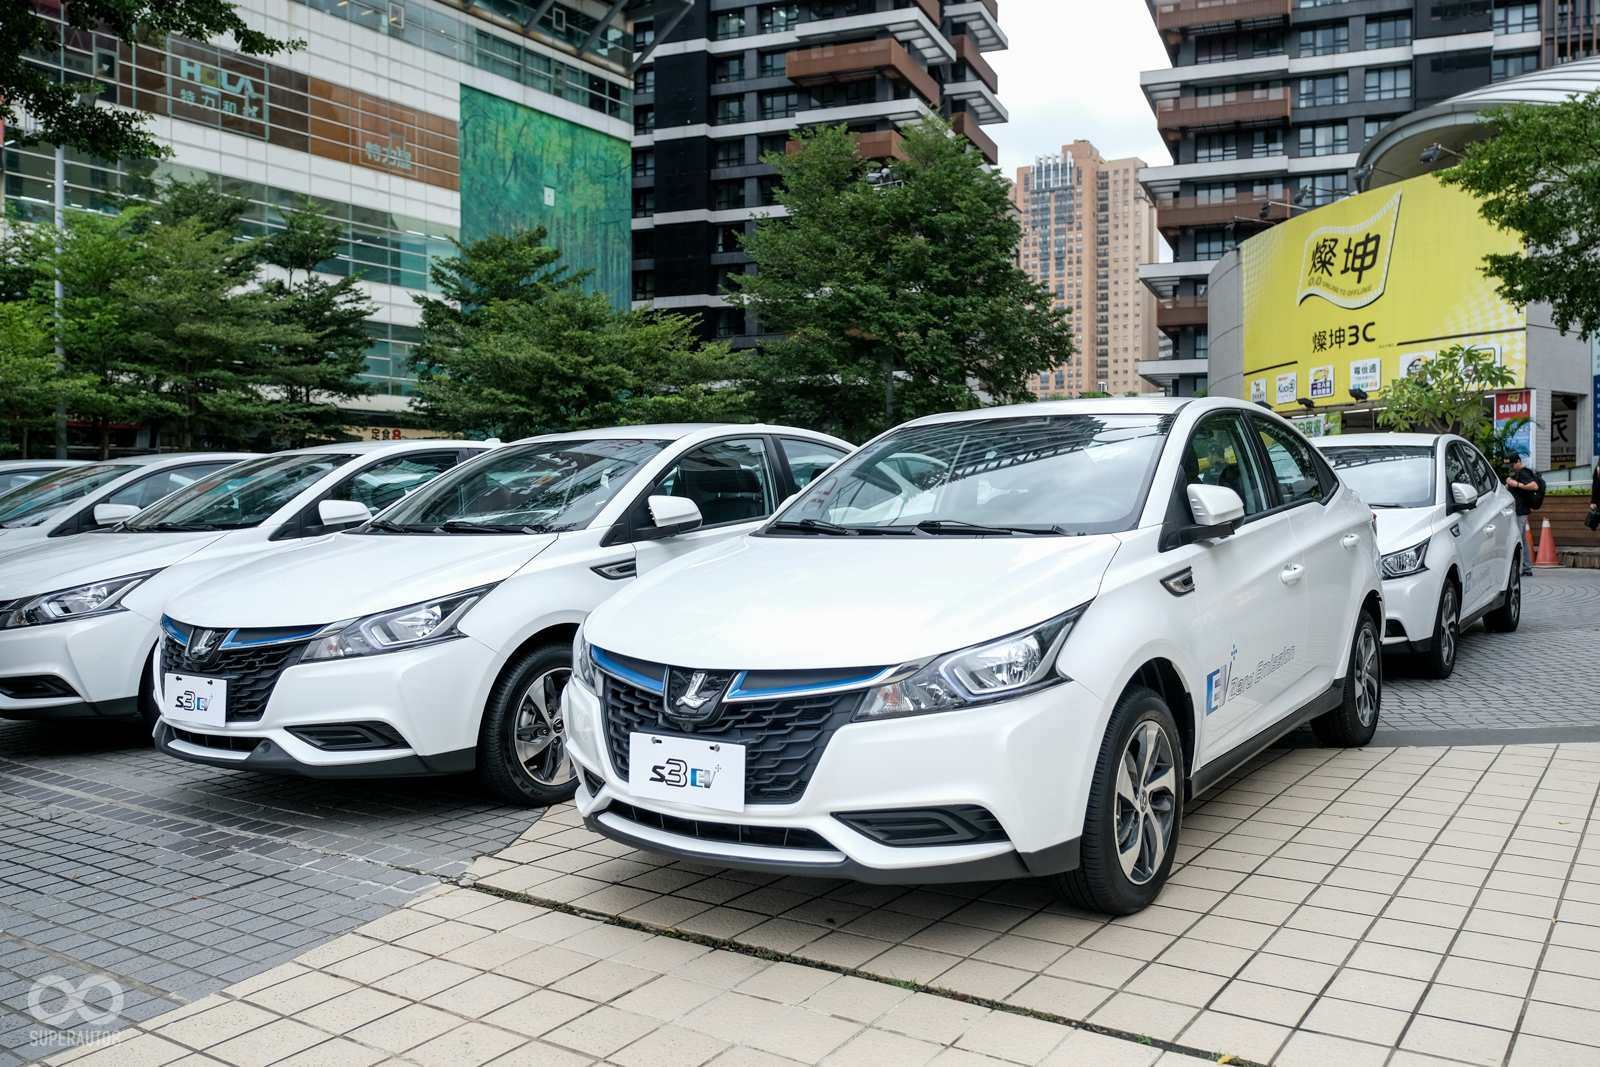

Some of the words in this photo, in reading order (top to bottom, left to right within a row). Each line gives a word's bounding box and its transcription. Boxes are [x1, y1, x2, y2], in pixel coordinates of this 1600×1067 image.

[180, 58, 257, 99] HOLA
[1308, 232, 1381, 284] 燦坤
[1499, 403, 1528, 414] SAMPO
[1228, 672, 1255, 702] Zero
[1254, 645, 1296, 684] Emission
